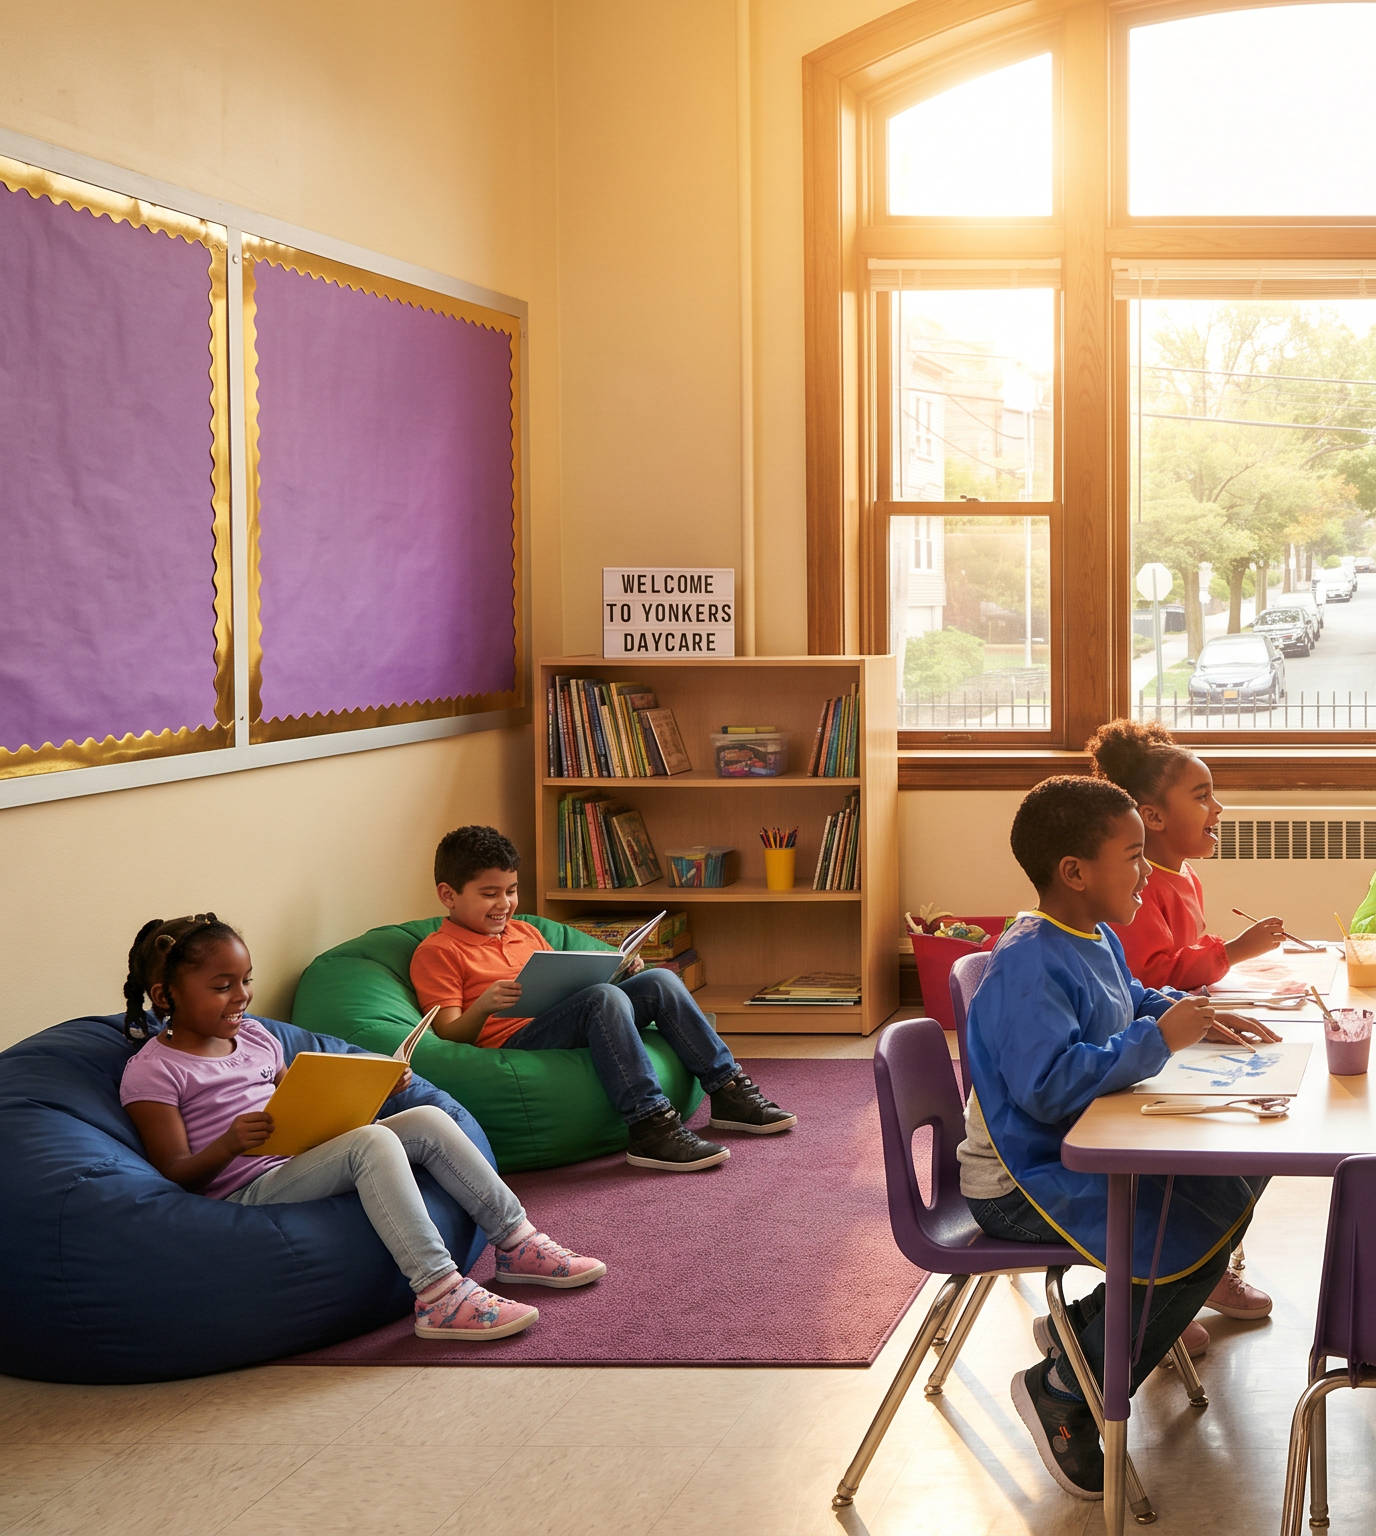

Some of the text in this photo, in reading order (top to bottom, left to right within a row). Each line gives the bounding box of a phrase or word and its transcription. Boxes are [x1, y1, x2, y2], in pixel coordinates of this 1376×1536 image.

[621, 574, 714, 594] WELCOME
[606, 603, 732, 623] TO YONKERS
[623, 632, 716, 652] DAYCARE
